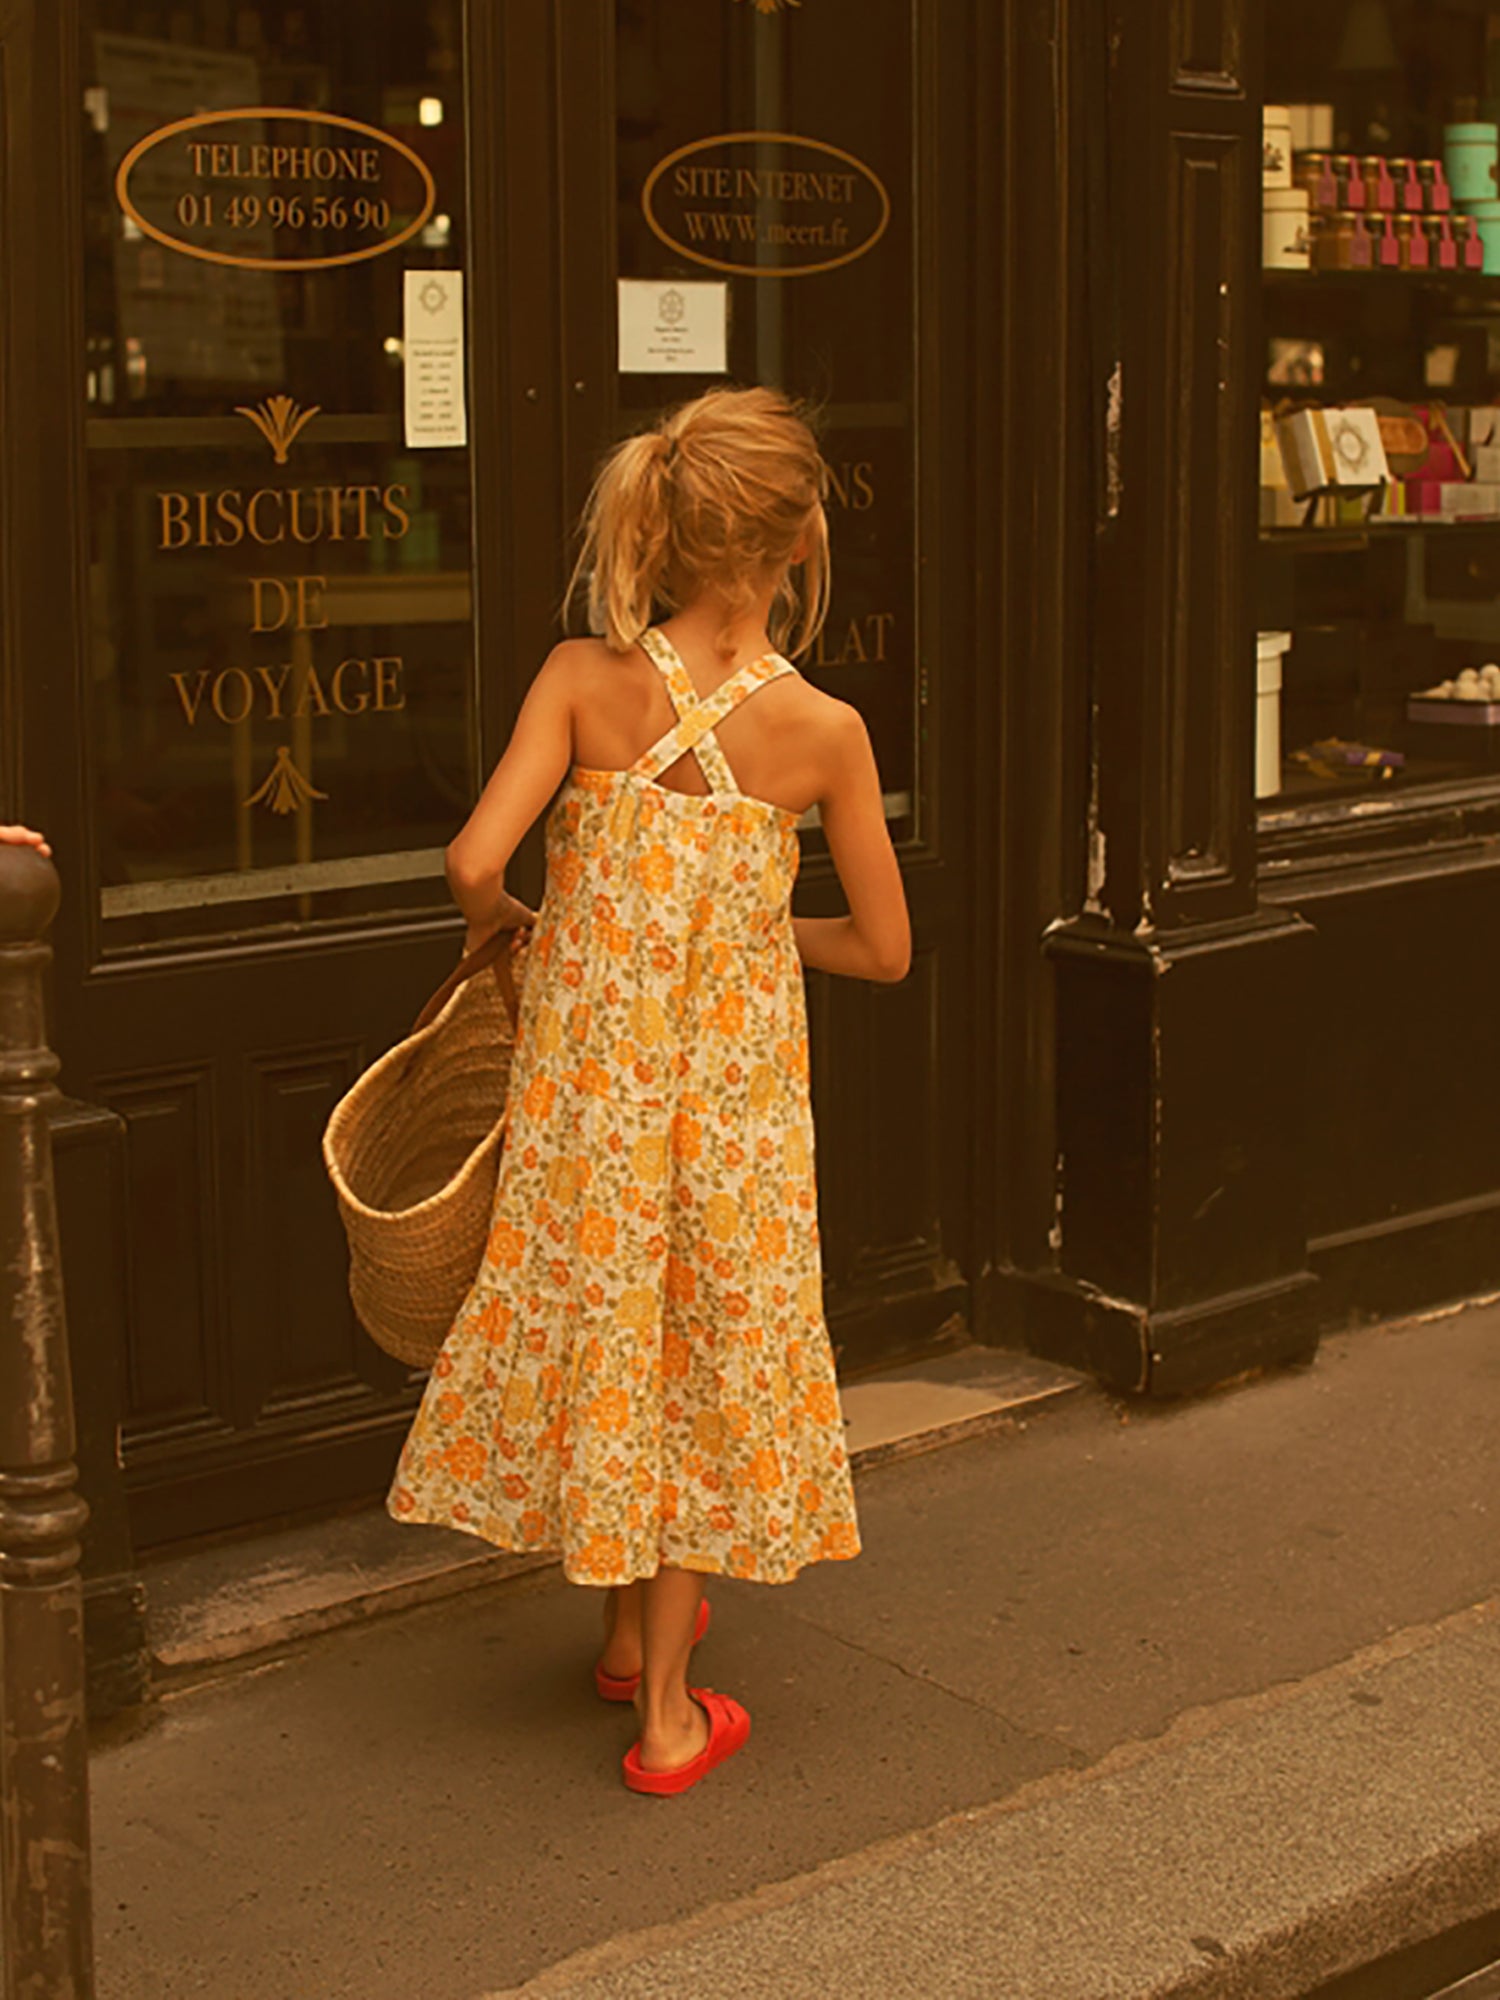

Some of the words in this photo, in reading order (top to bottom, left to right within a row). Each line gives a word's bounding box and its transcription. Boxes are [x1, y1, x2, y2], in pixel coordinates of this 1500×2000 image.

[187, 143, 380, 183] TELEPHONE
[673, 165, 731, 199] SITE
[735, 168, 858, 204] INTERNET
[177, 193, 213, 228] 01
[223, 194, 262, 229] 49
[267, 195, 305, 229] 96
[311, 196, 348, 229] 56
[353, 197, 391, 230] 90
[822, 461, 875, 511] NS
[157, 483, 411, 549] BISCUITS
[249, 574, 329, 633] DE
[169, 655, 406, 727] VOYAGE
